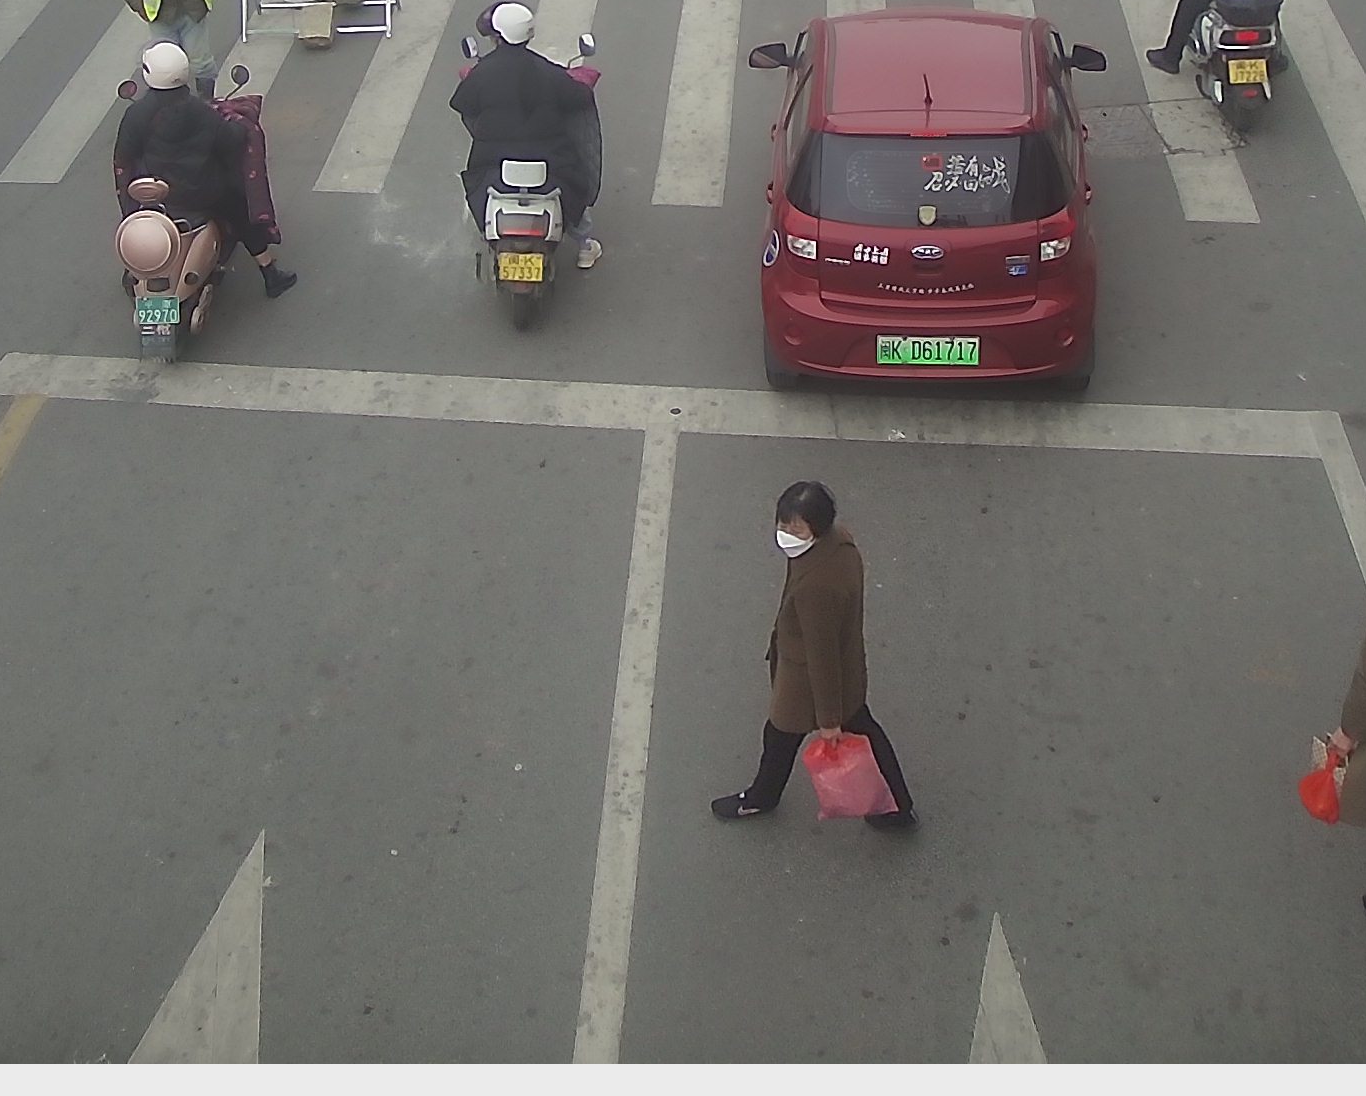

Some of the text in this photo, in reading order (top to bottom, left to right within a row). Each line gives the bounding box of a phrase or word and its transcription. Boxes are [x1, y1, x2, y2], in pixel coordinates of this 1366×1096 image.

[502, 266, 541, 279] 57337
[139, 309, 177, 322] 92970
[912, 341, 977, 360] D61717
